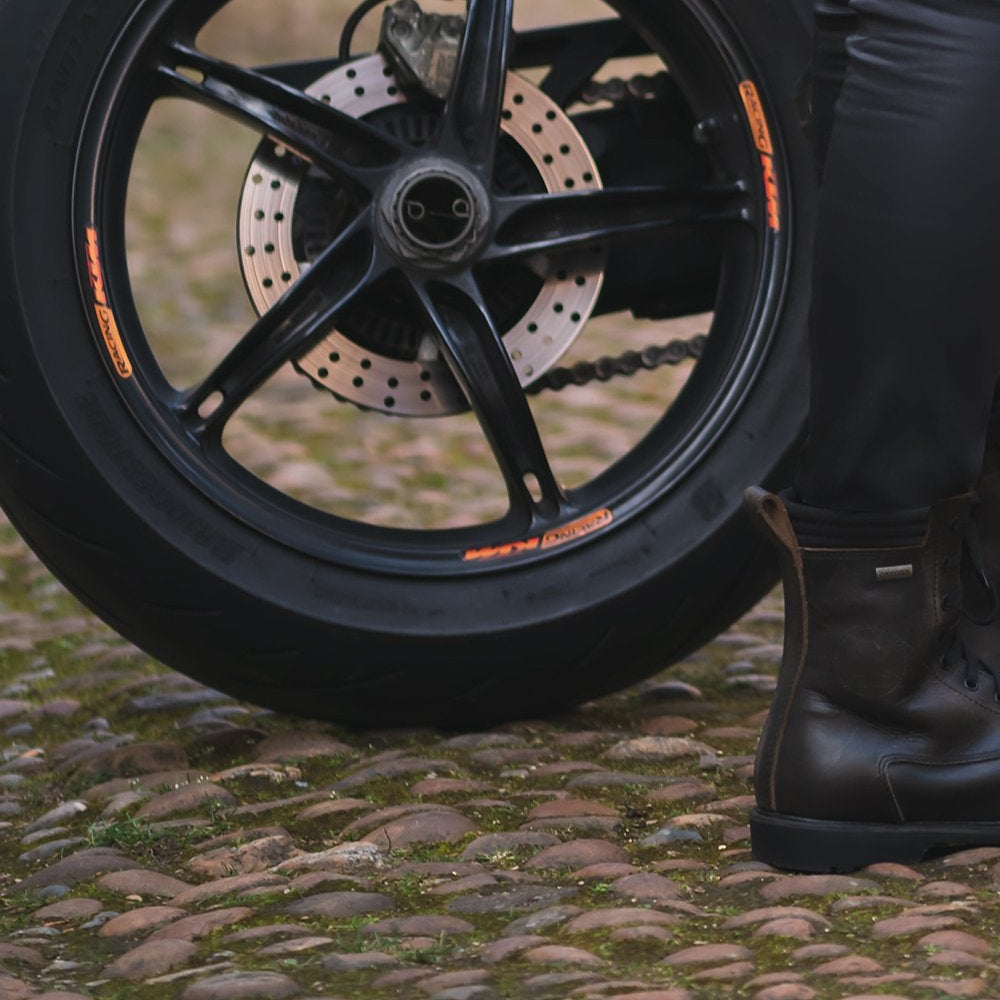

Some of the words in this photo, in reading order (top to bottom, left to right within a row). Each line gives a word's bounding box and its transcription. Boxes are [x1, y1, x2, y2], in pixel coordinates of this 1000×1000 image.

[760, 155, 780, 231] KTM
[86, 228, 107, 304] KTM
[97, 307, 131, 376] RACING
